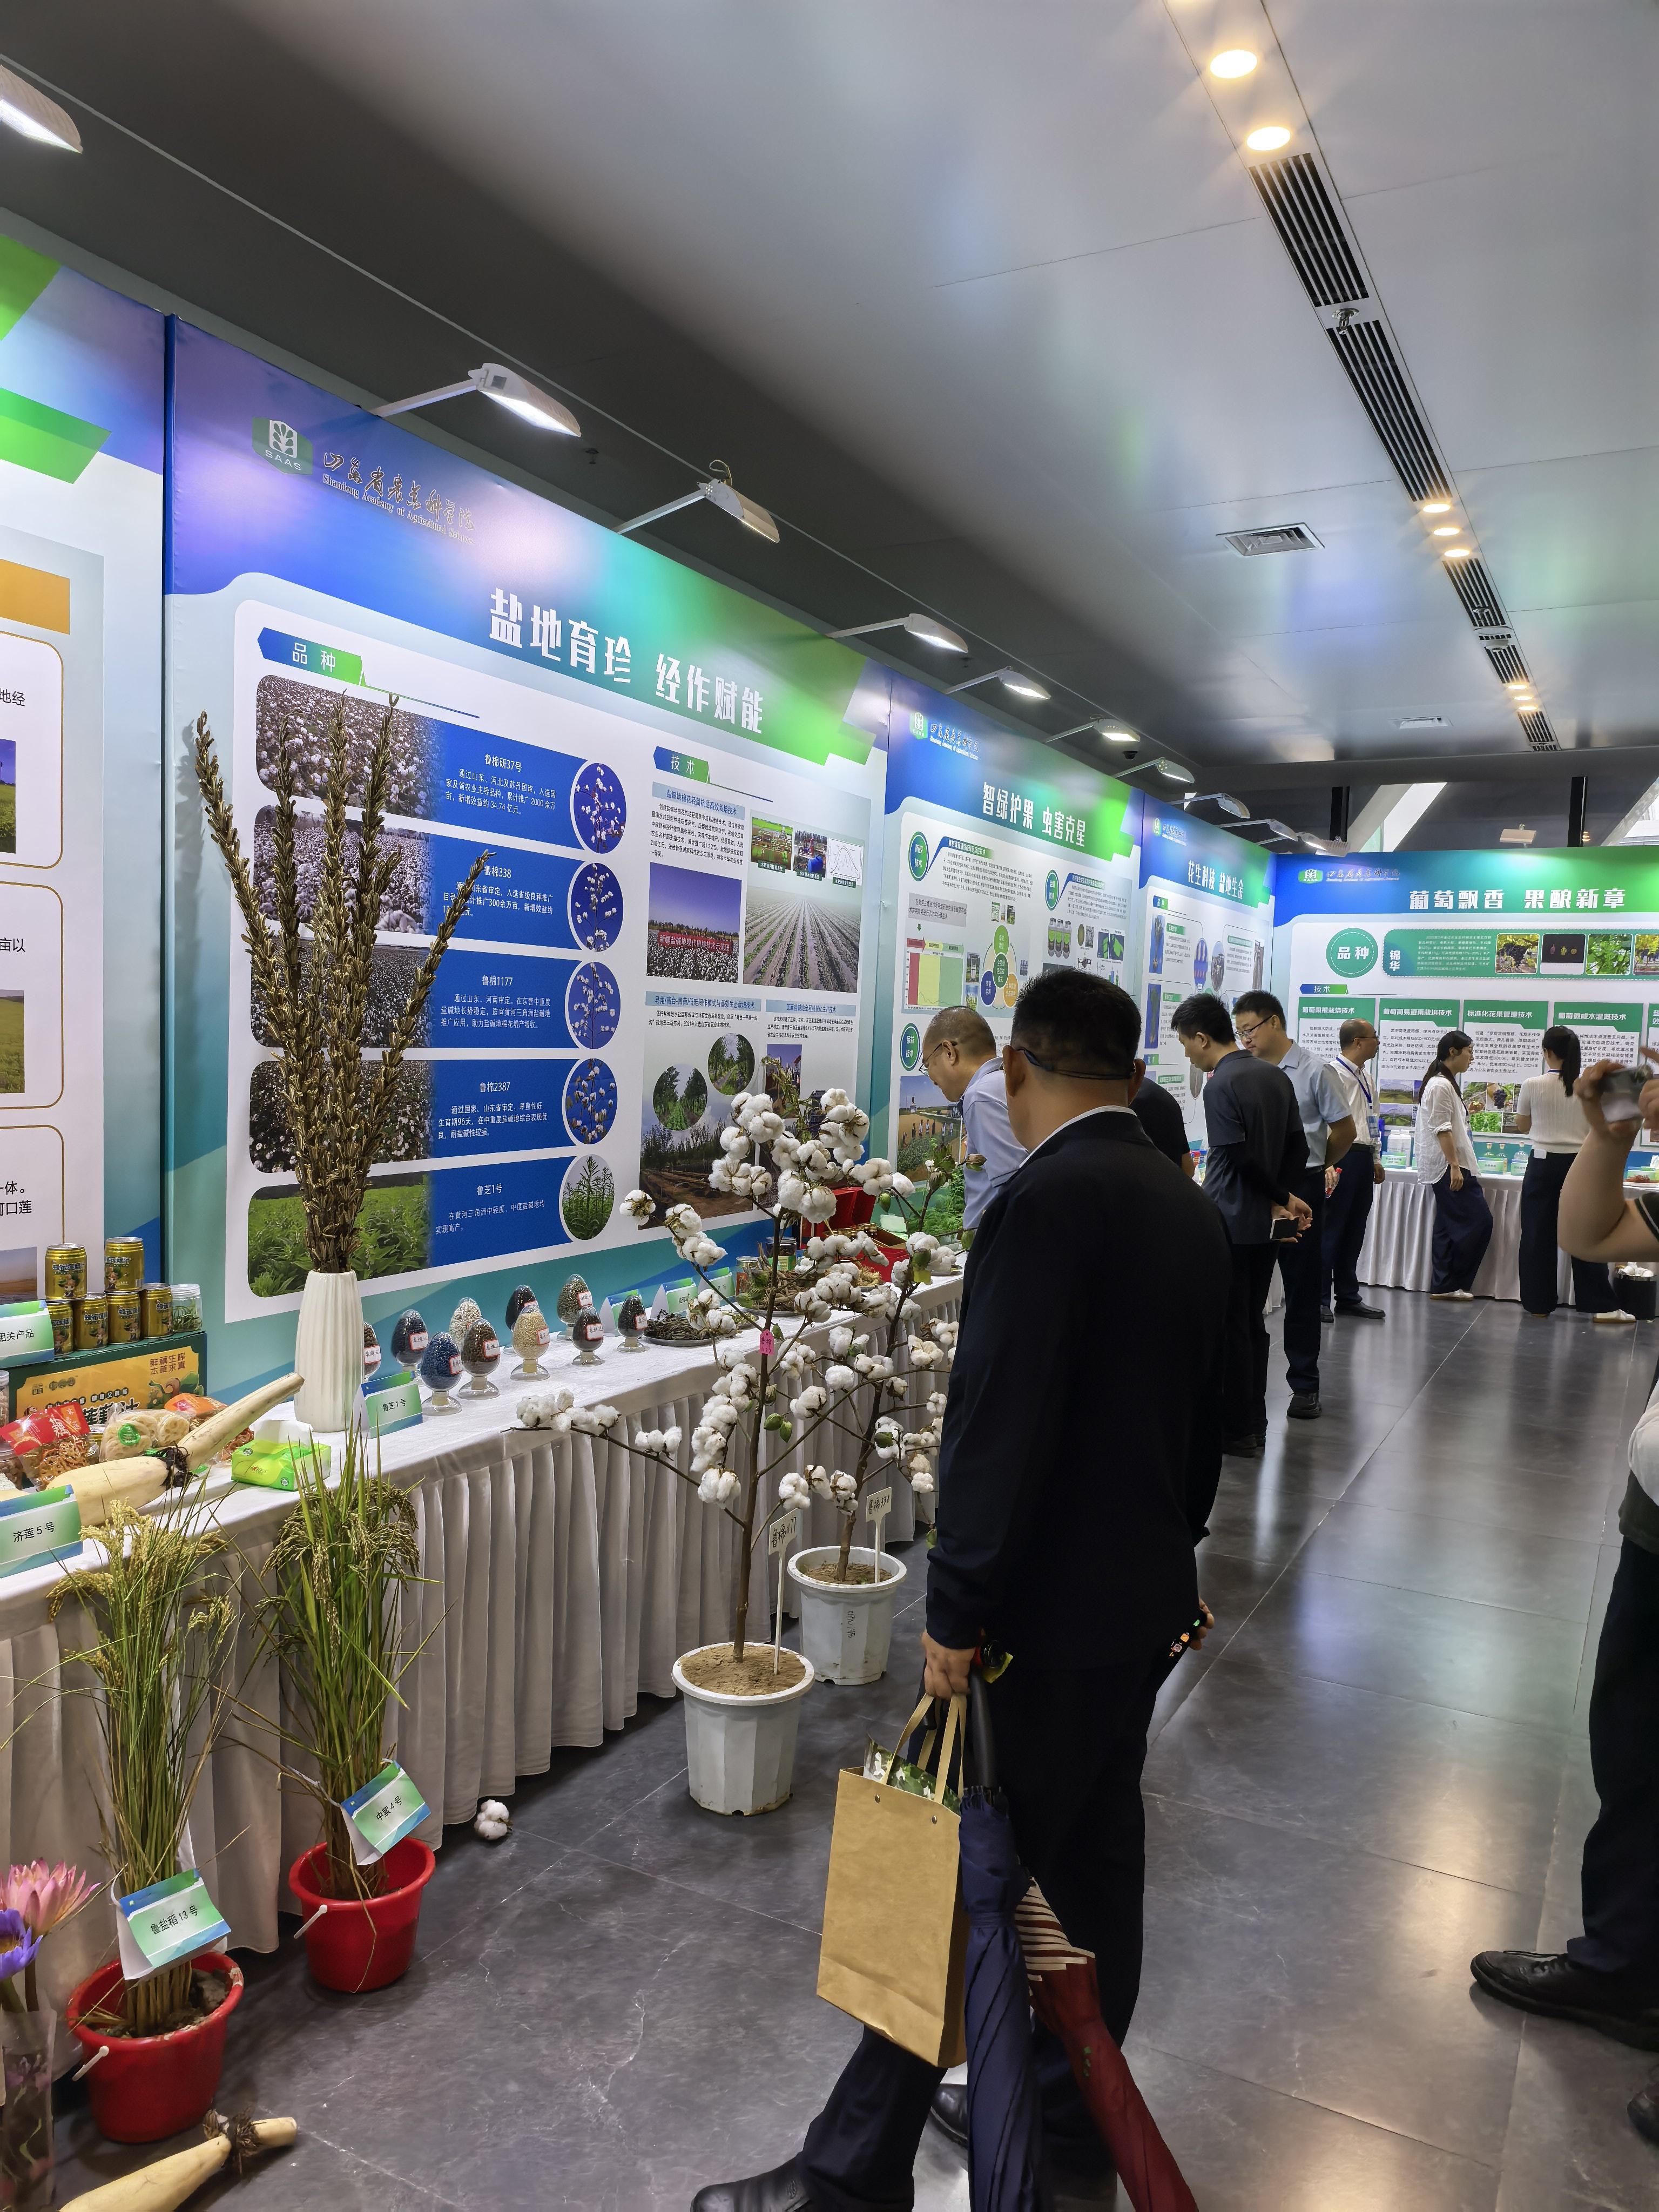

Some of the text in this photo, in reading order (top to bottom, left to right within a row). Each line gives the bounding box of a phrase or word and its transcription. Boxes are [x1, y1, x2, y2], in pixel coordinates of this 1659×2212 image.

[265, 449, 301, 471] SAAS
[322, 474, 359, 500] Shandong
[362, 492, 394, 514] Academy
[397, 507, 405, 517] of
[407, 509, 447, 535] Agricultural
[292, 642, 336, 673] 品种
[489, 588, 764, 734] 盐地育珍 经作赋能
[485, 754, 522, 772] 鲁棉研37号
[671, 754, 695, 775] 技术
[983, 781, 1085, 847] 智绿护果 虫害克星
[484, 865, 511, 879] 鲁棉338
[914, 858, 922, 867] 技术
[1188, 860, 1215, 890] 花生科技
[1410, 888, 1626, 909] 葡萄飘香 果酿新章
[0, 938, 26, 953] 亩以
[1337, 946, 1369, 960] 品种
[1389, 950, 1400, 971] 锦华
[482, 975, 513, 986] 鲁棉1177
[1467, 1010, 1532, 1018] 标准化花果管理技术
[480, 1082, 510, 1092] 鲁棉2387
[477, 1183, 503, 1196] 鲁芝1号
[382, 1398, 406, 1412] 鲁芝1号
[13, 1522, 55, 1542] 济莲5号
[376, 1795, 403, 1822] 中紫4号
[150, 1905, 199, 1935] 鲁盐稻13号
